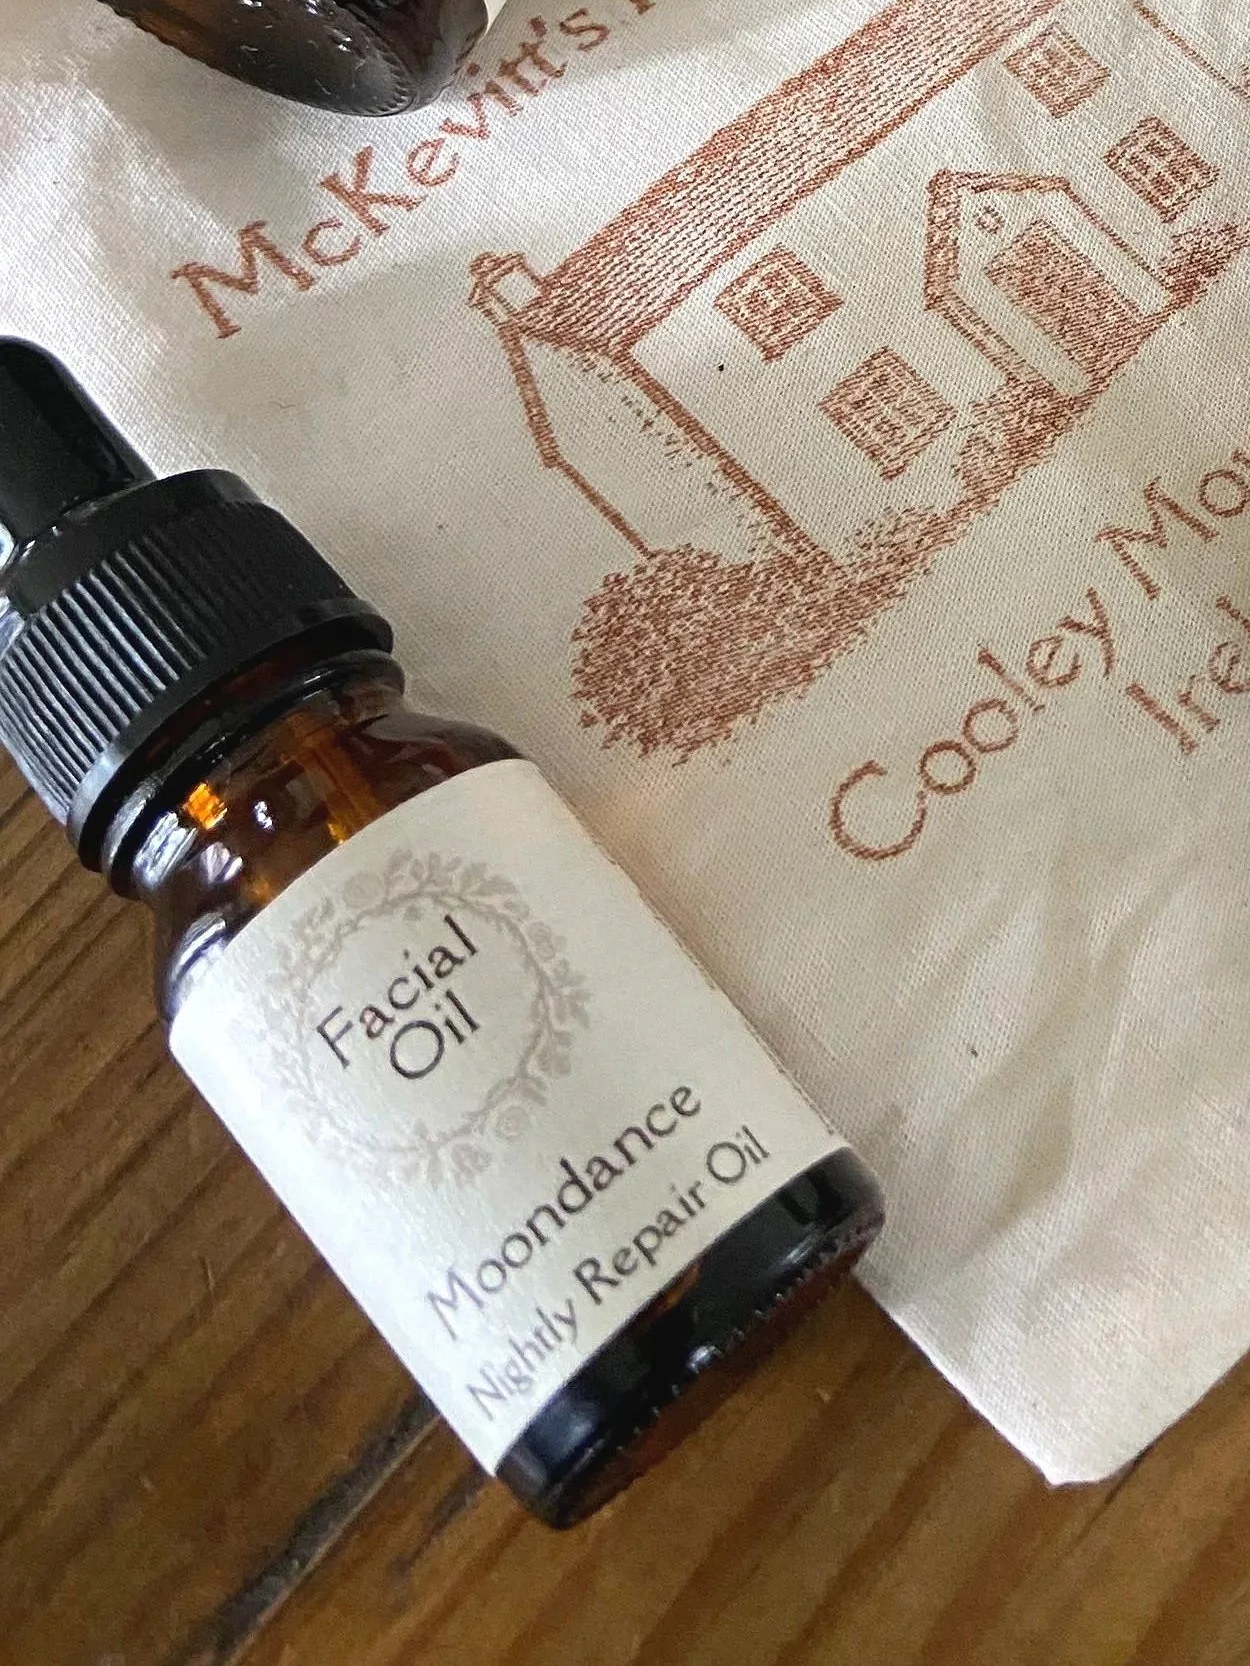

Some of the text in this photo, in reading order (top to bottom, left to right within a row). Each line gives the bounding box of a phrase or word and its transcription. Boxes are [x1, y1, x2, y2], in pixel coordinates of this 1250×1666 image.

[172, 6, 611, 340] McKevitt's
[828, 587, 1117, 862] Cooley
[315, 912, 481, 1071] Facial
[388, 988, 482, 1081] Oil
[426, 1080, 703, 1343] Moondance
[465, 1123, 773, 1422] Nightly Repair Oil
